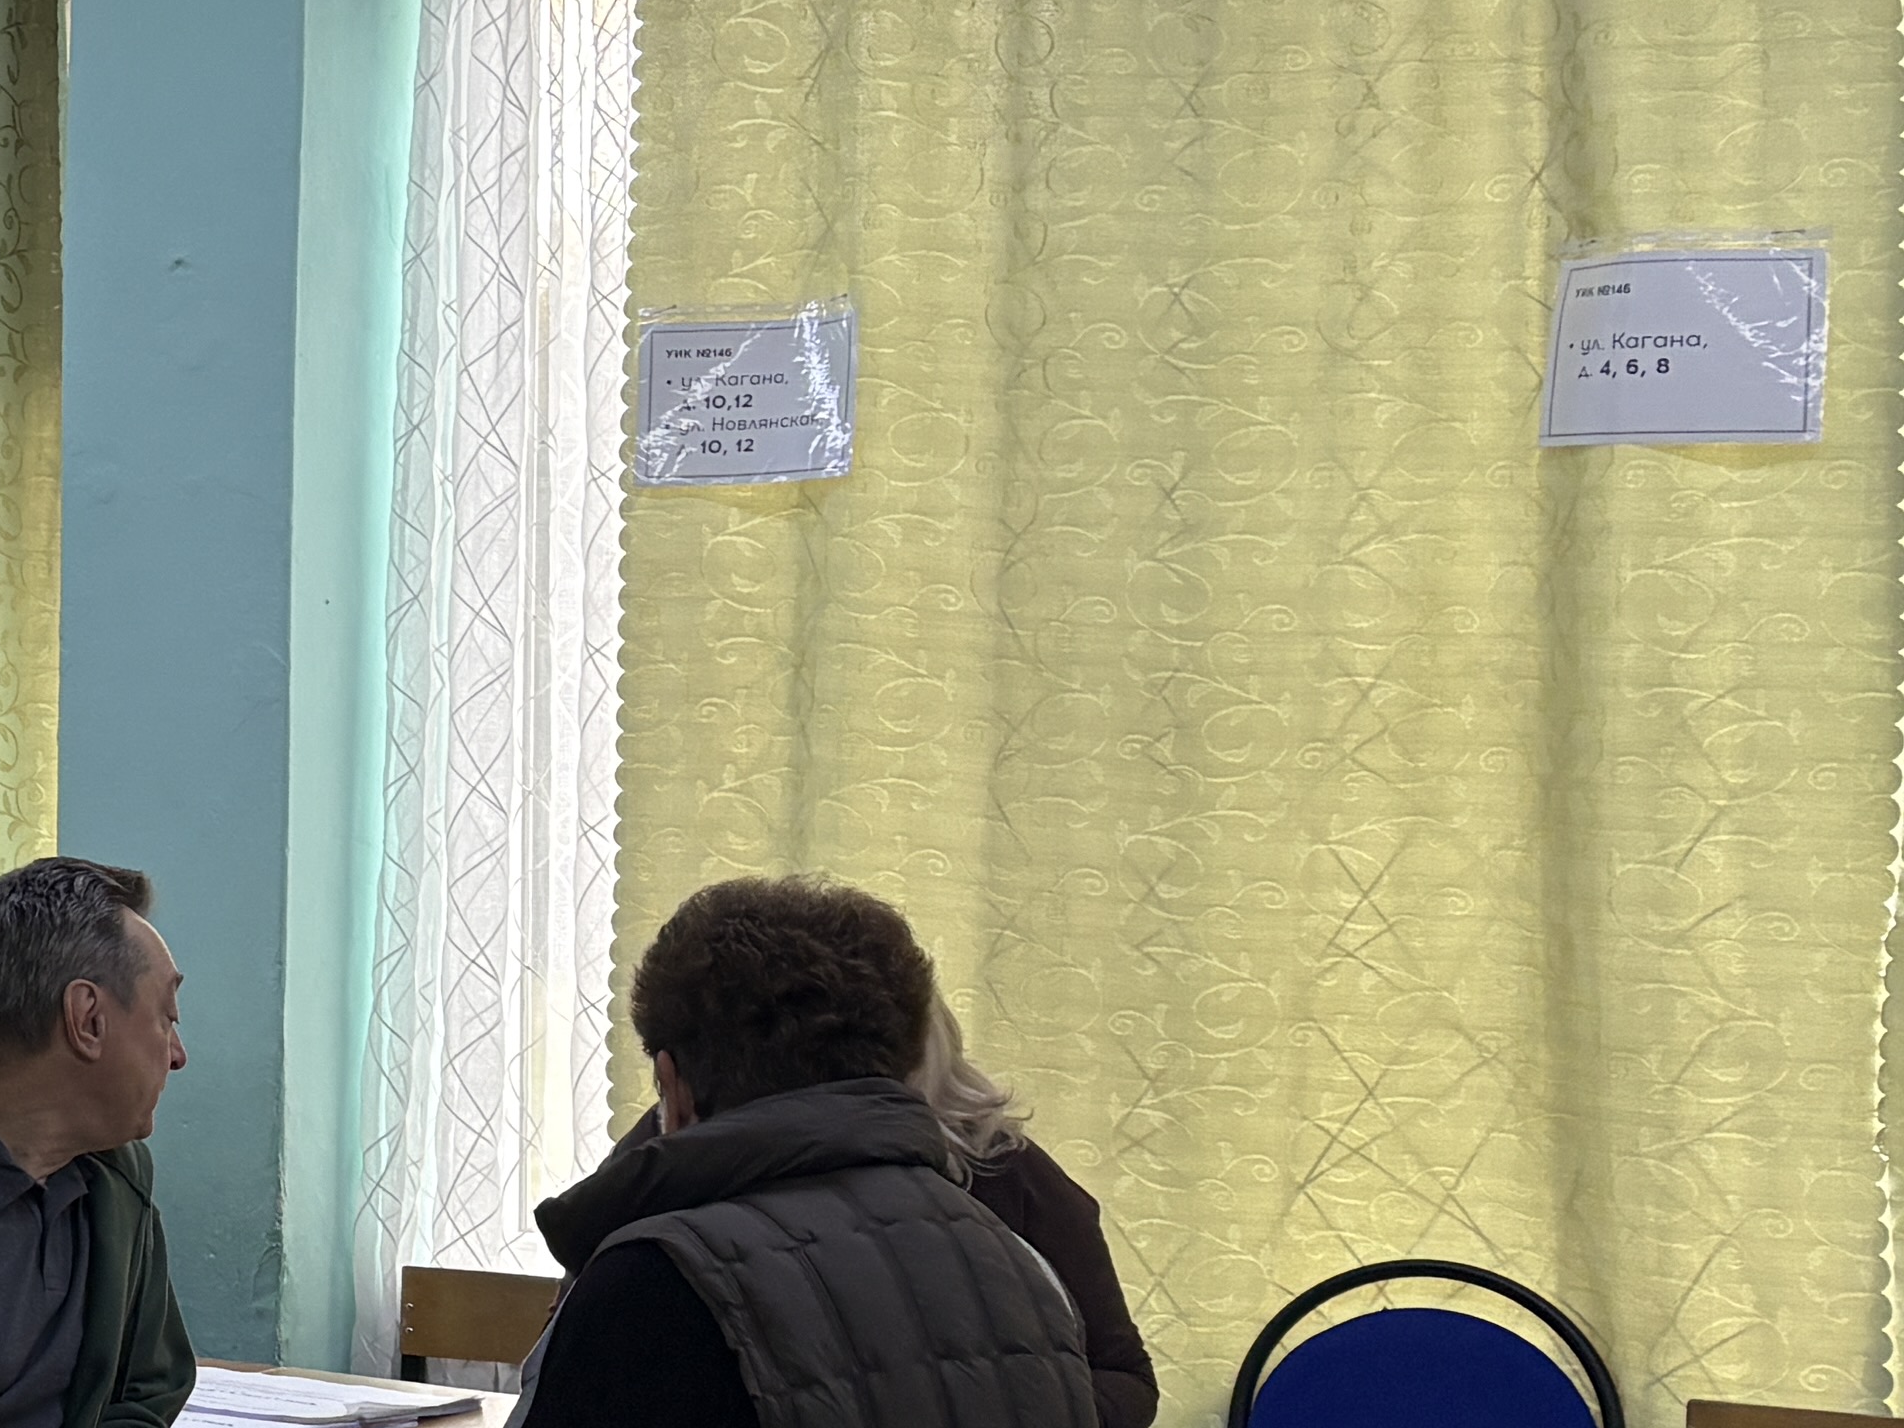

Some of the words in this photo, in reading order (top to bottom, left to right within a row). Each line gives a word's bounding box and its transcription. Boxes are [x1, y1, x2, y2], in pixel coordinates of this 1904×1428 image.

[1612, 332, 1708, 349] Кагана,
[665, 348, 691, 358] УИК
[1599, 359, 1617, 378] 4,
[1626, 359, 1646, 377] 6,
[1656, 357, 1670, 373] 8
[700, 440, 728, 456] 10,
[736, 438, 754, 452] 12
